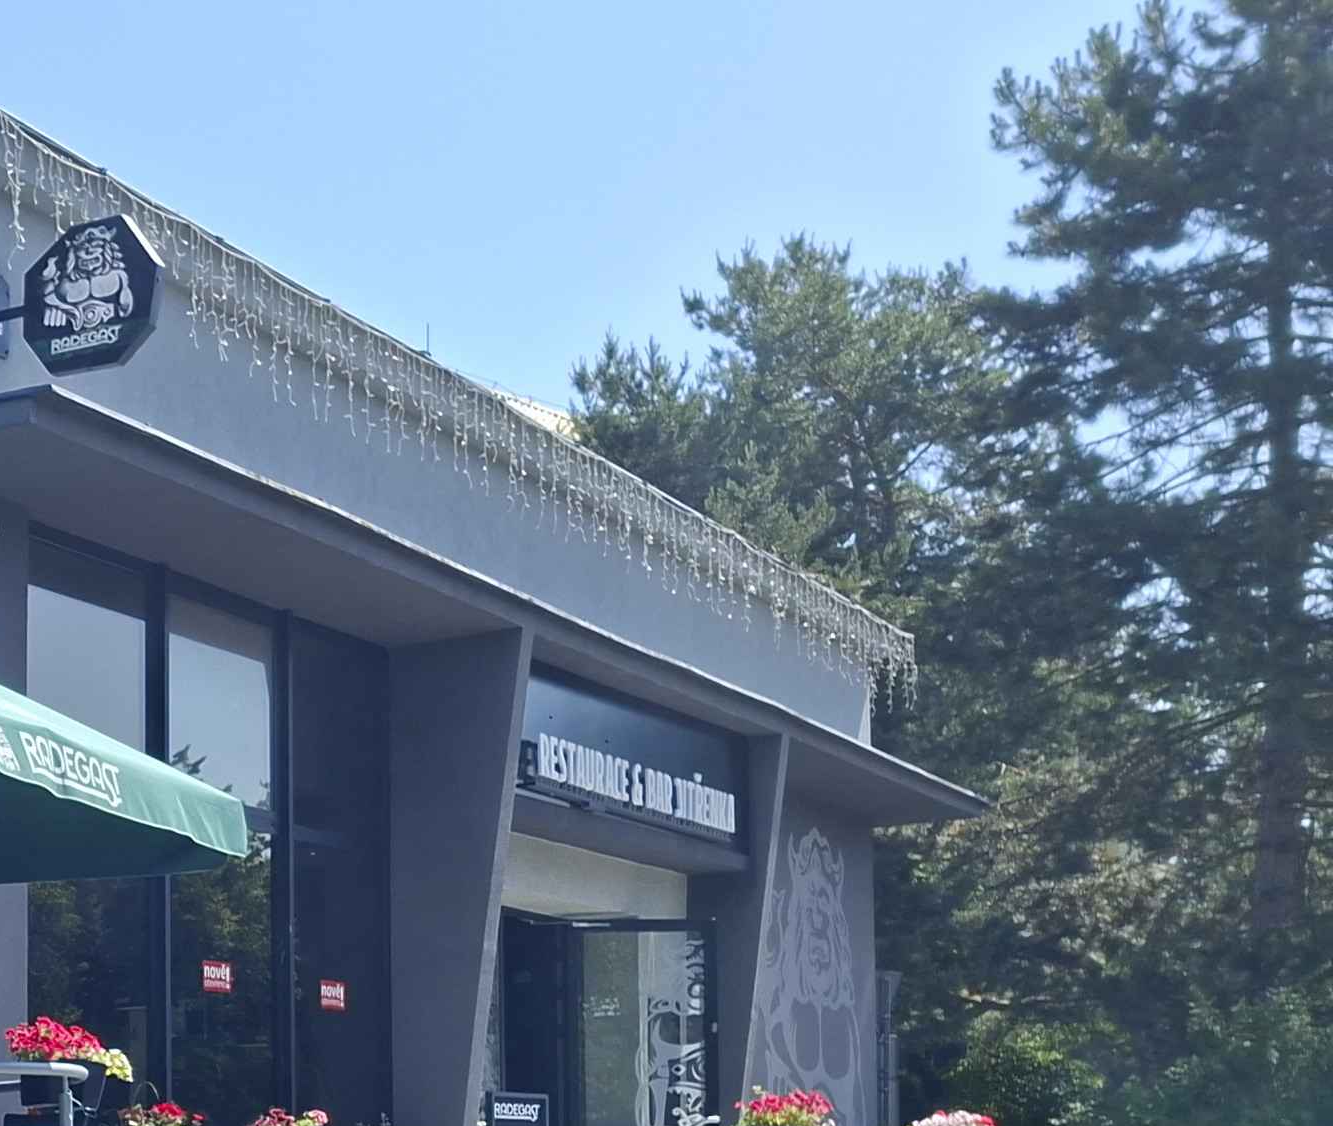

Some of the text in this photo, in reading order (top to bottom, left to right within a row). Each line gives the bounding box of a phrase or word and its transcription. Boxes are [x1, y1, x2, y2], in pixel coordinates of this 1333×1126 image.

[51, 325, 122, 355] RADEGAST
[19, 731, 122, 807] RADEGAST
[538, 732, 630, 802] RESTAURACE
[632, 763, 643, 806] &
[645, 768, 673, 815] BAR
[494, 1103, 540, 1122] RADEGAST
